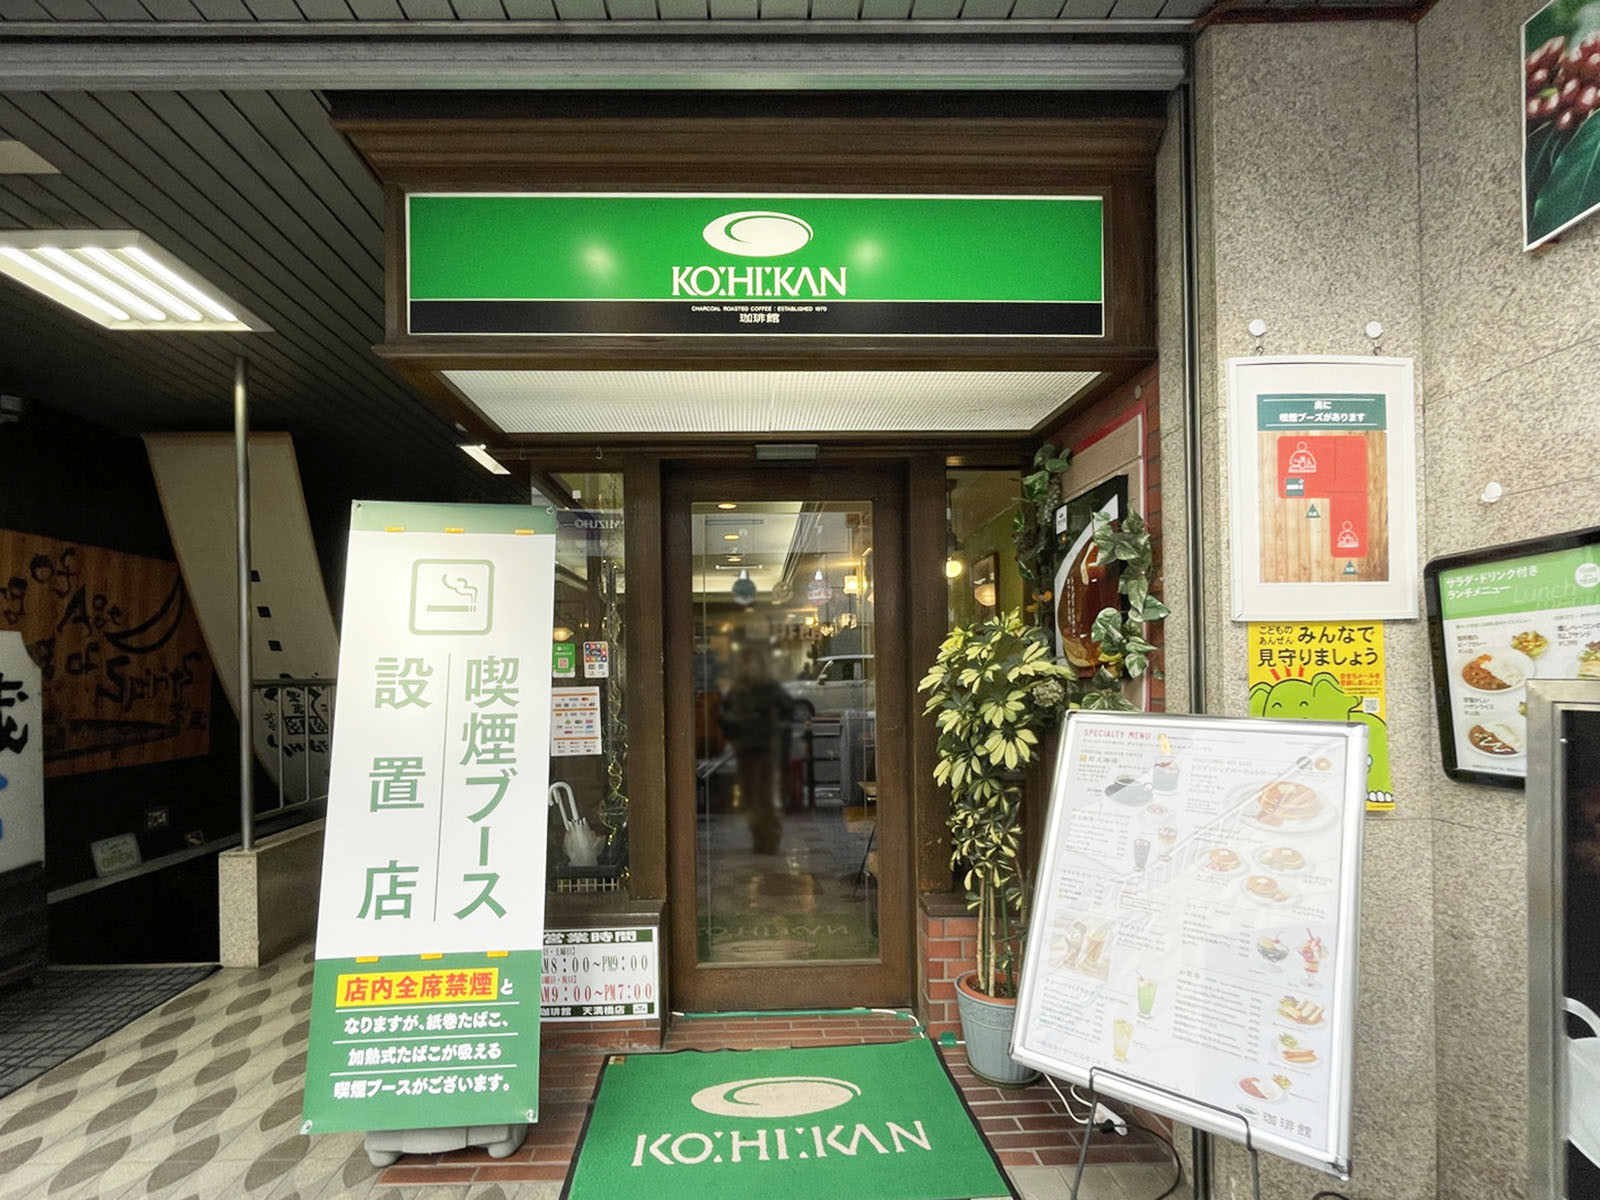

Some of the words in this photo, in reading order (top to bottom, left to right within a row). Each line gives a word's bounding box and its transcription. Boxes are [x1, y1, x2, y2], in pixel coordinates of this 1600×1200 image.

[739, 313, 780, 324] 珈琲館
[1447, 585, 1511, 600] ランチメニュー
[1258, 636, 1294, 646] あんぜん
[1259, 625, 1293, 636] こどもの
[1297, 626, 1376, 644] みんなで
[1257, 647, 1379, 668] 見守りましょう
[1083, 728, 1126, 740] SPECIALTY
[1127, 731, 1151, 741] MENU
[357, 656, 433, 920] 設置店
[454, 656, 520, 919] 喫煙ブース
[543, 930, 637, 945] 営業時間
[344, 1011, 509, 1035] なりますが、紙巻たばこ、
[347, 1042, 502, 1066] 加熱式たばこが吸える
[333, 1073, 510, 1099] 喫煙ブースがございます。
